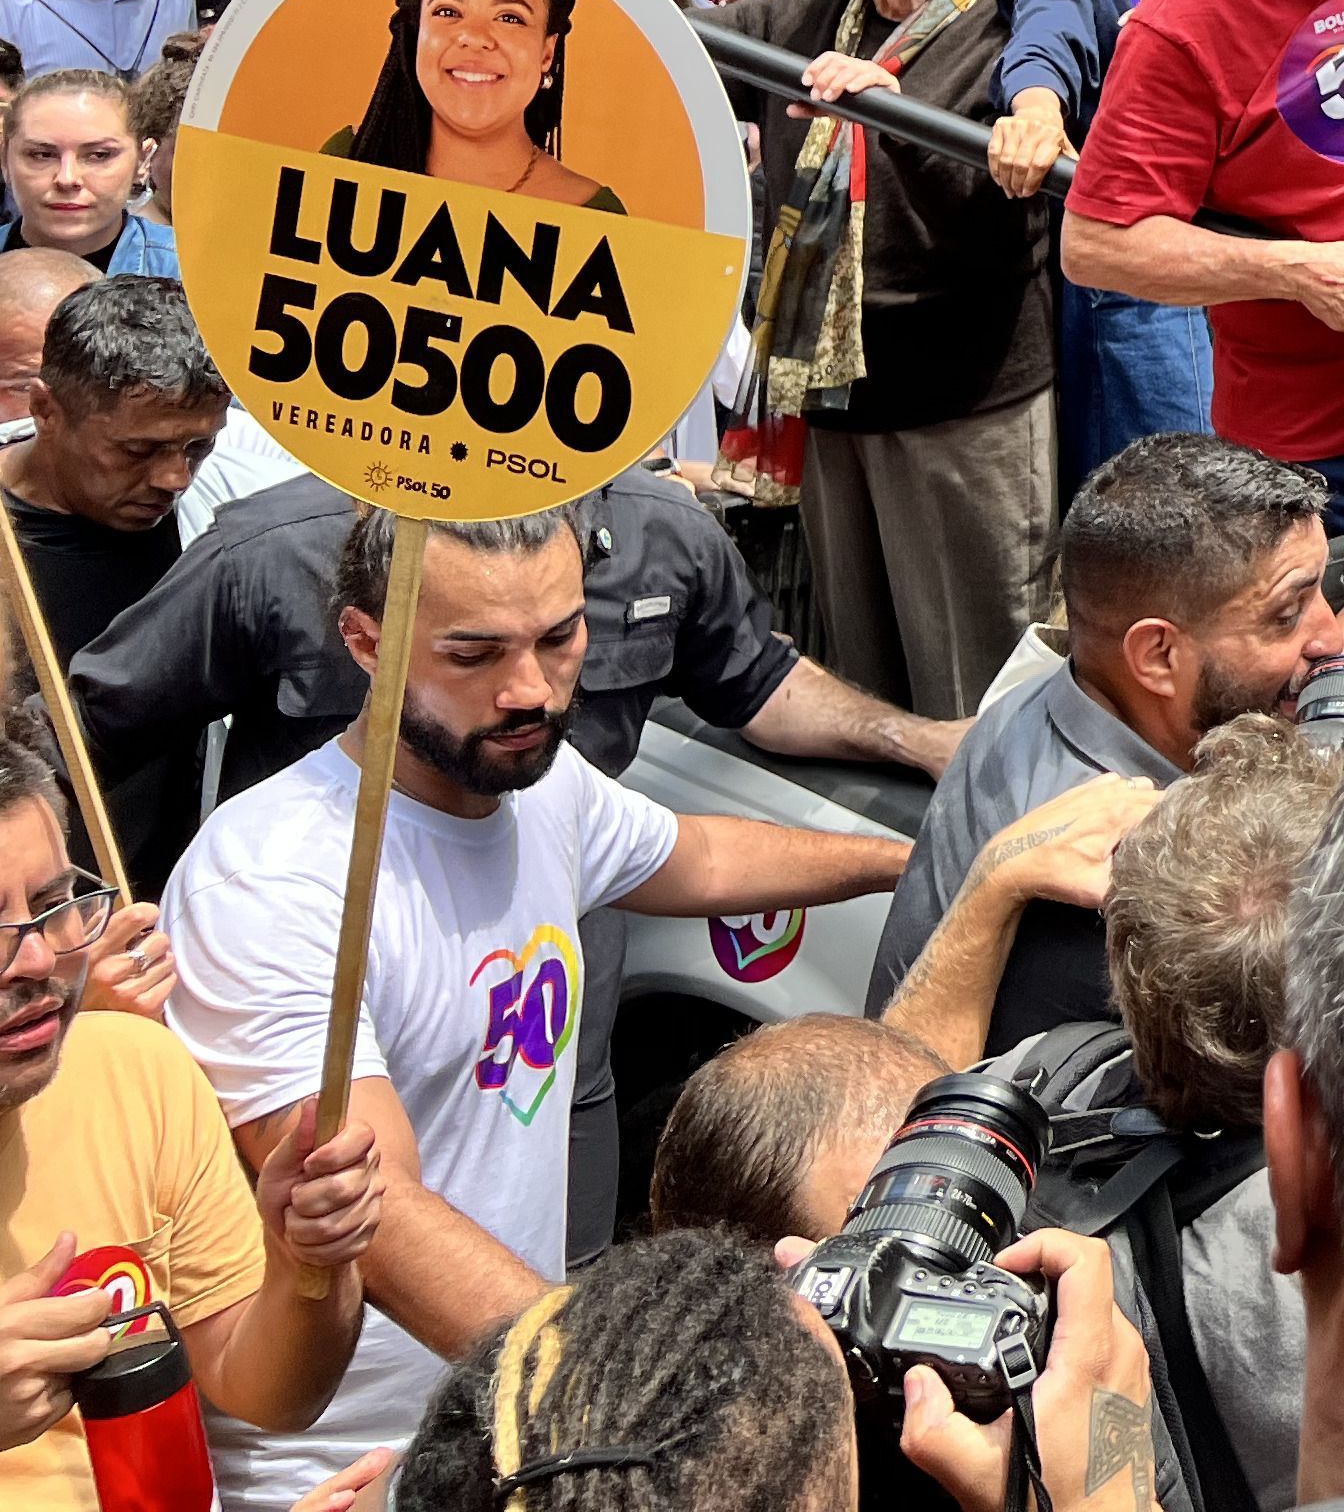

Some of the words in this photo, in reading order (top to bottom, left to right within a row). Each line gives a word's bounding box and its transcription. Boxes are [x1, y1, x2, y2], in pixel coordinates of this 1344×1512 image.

[269, 165, 635, 335] LUANA
[248, 272, 633, 453] 50500
[271, 401, 433, 456] VEREADORA
[485, 446, 568, 485] PSOL
[430, 482, 451, 500] 50
[476, 957, 569, 1093] 50
